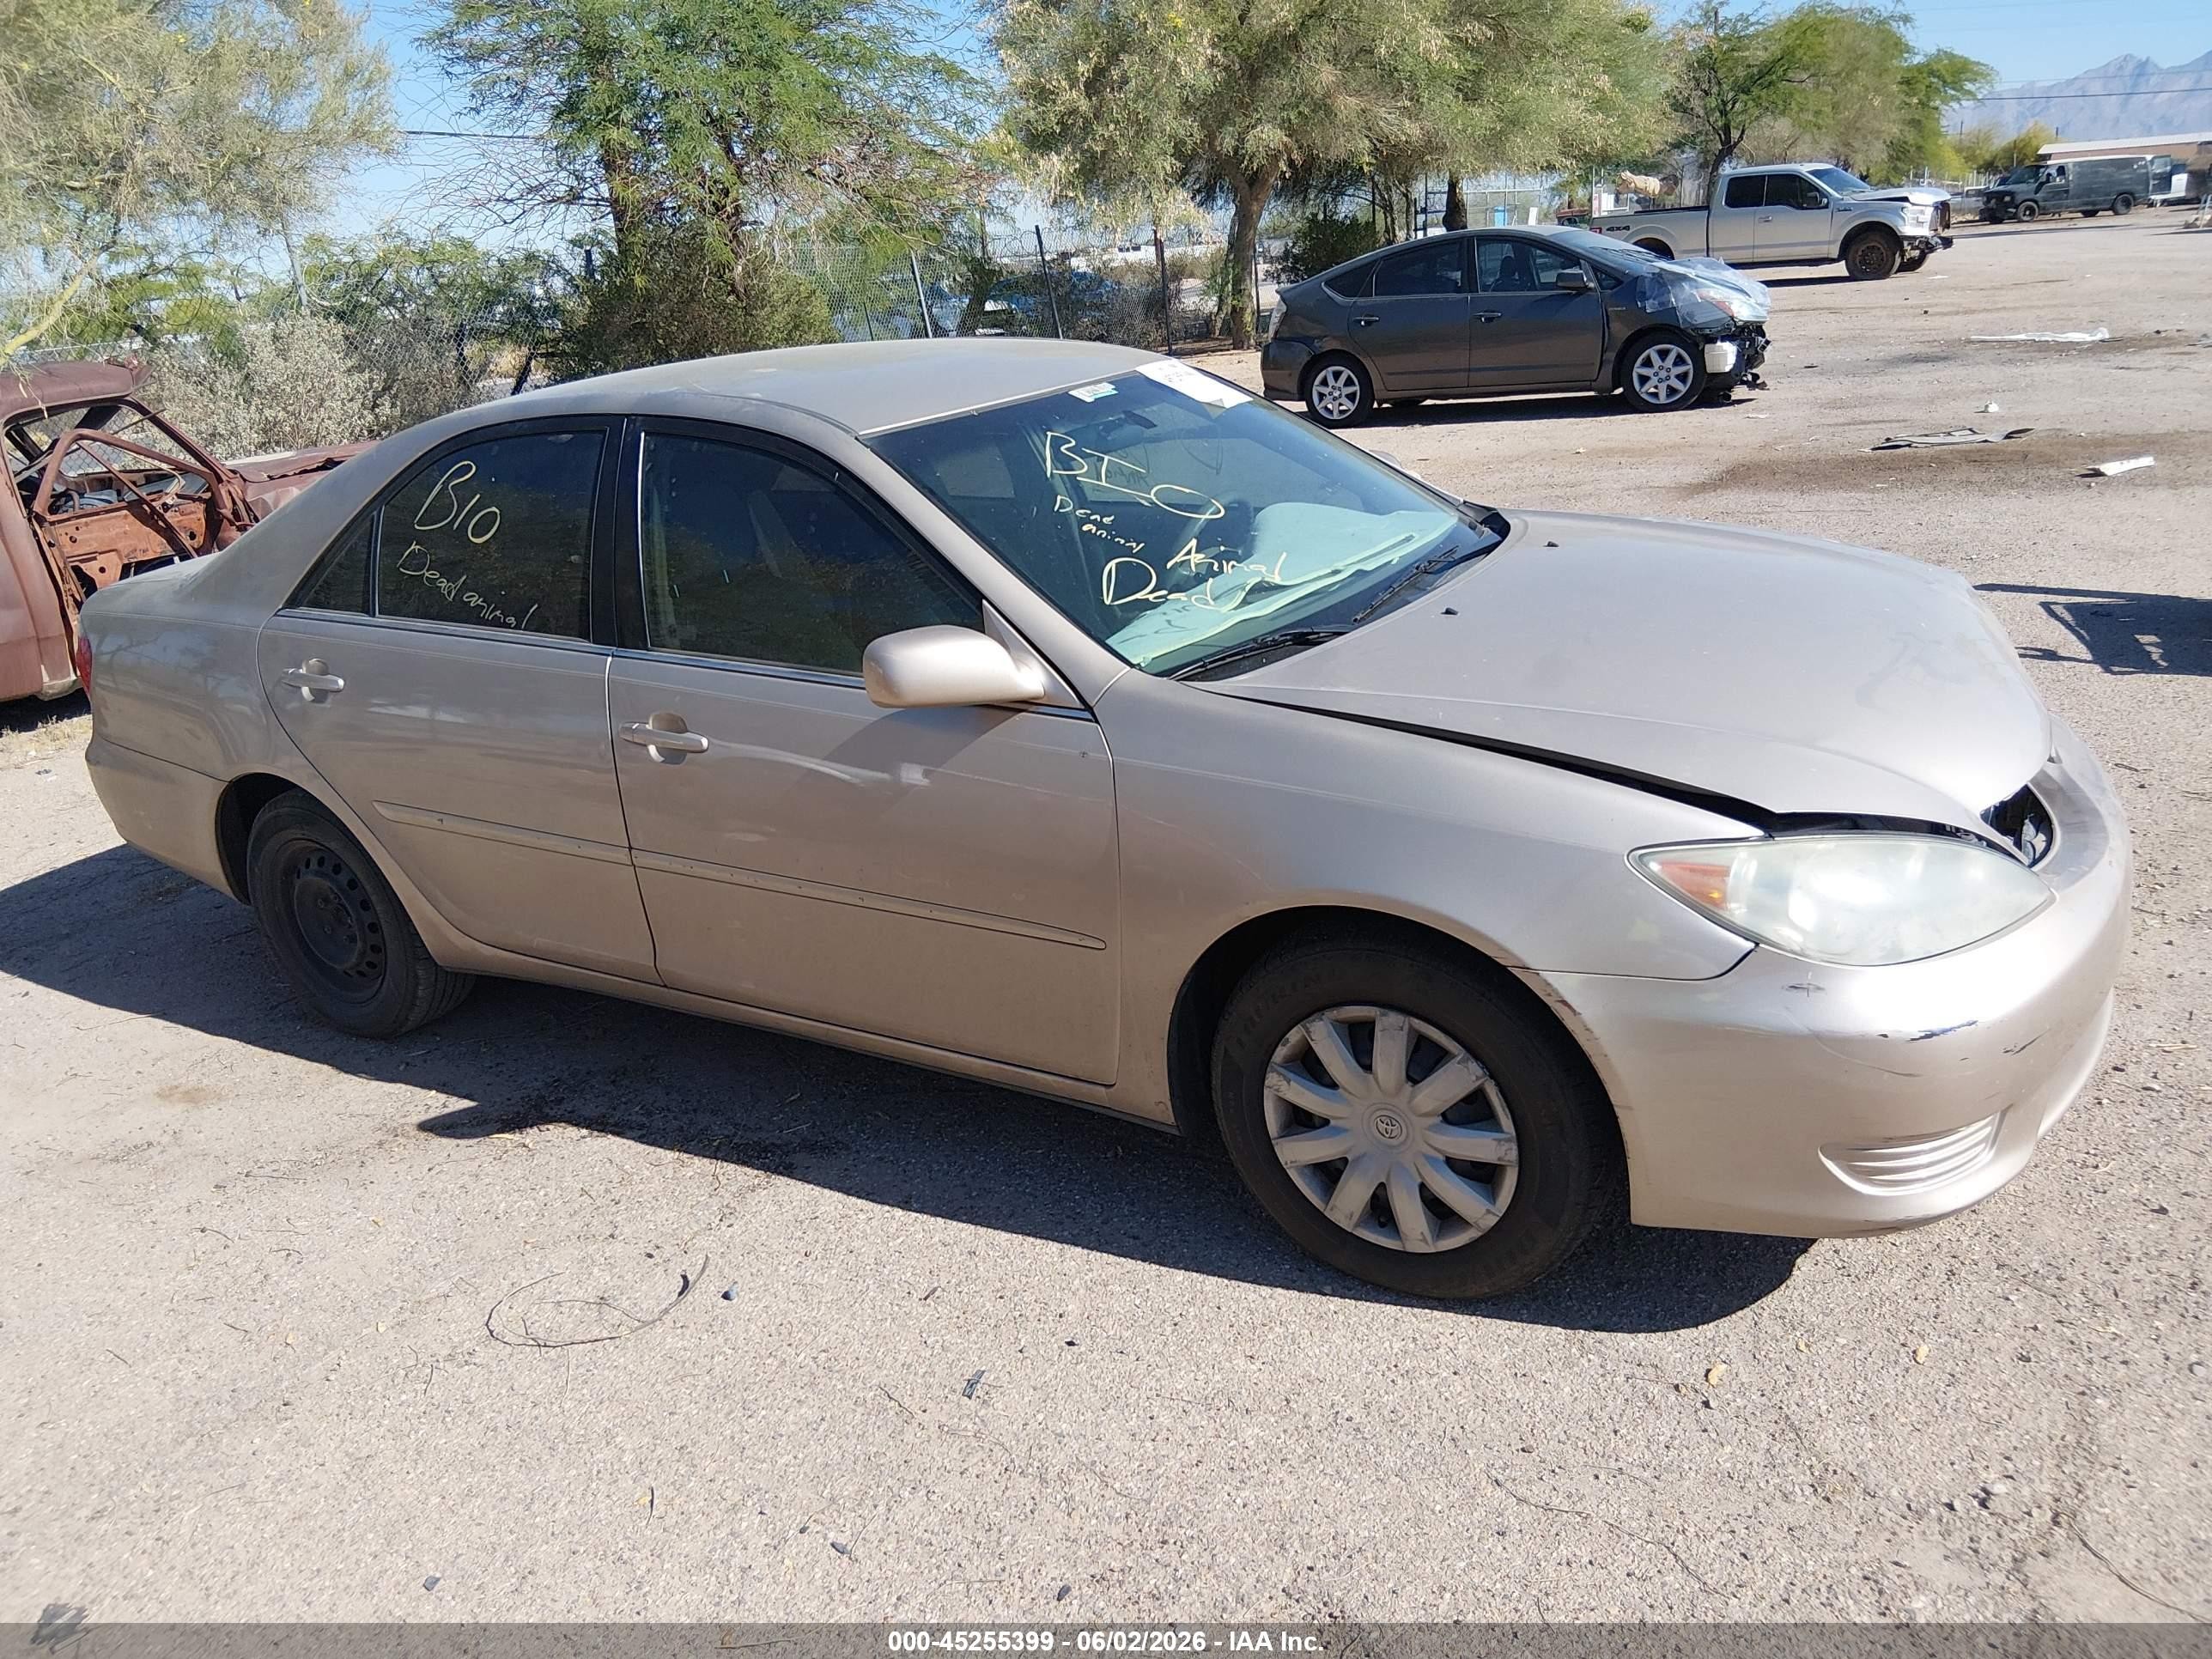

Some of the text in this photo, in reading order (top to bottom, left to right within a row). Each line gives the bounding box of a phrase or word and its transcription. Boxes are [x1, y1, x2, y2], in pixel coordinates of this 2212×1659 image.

[1046, 431, 1225, 520] BIO
[396, 541, 466, 602] Dead
[1102, 556, 1218, 611] Dead
